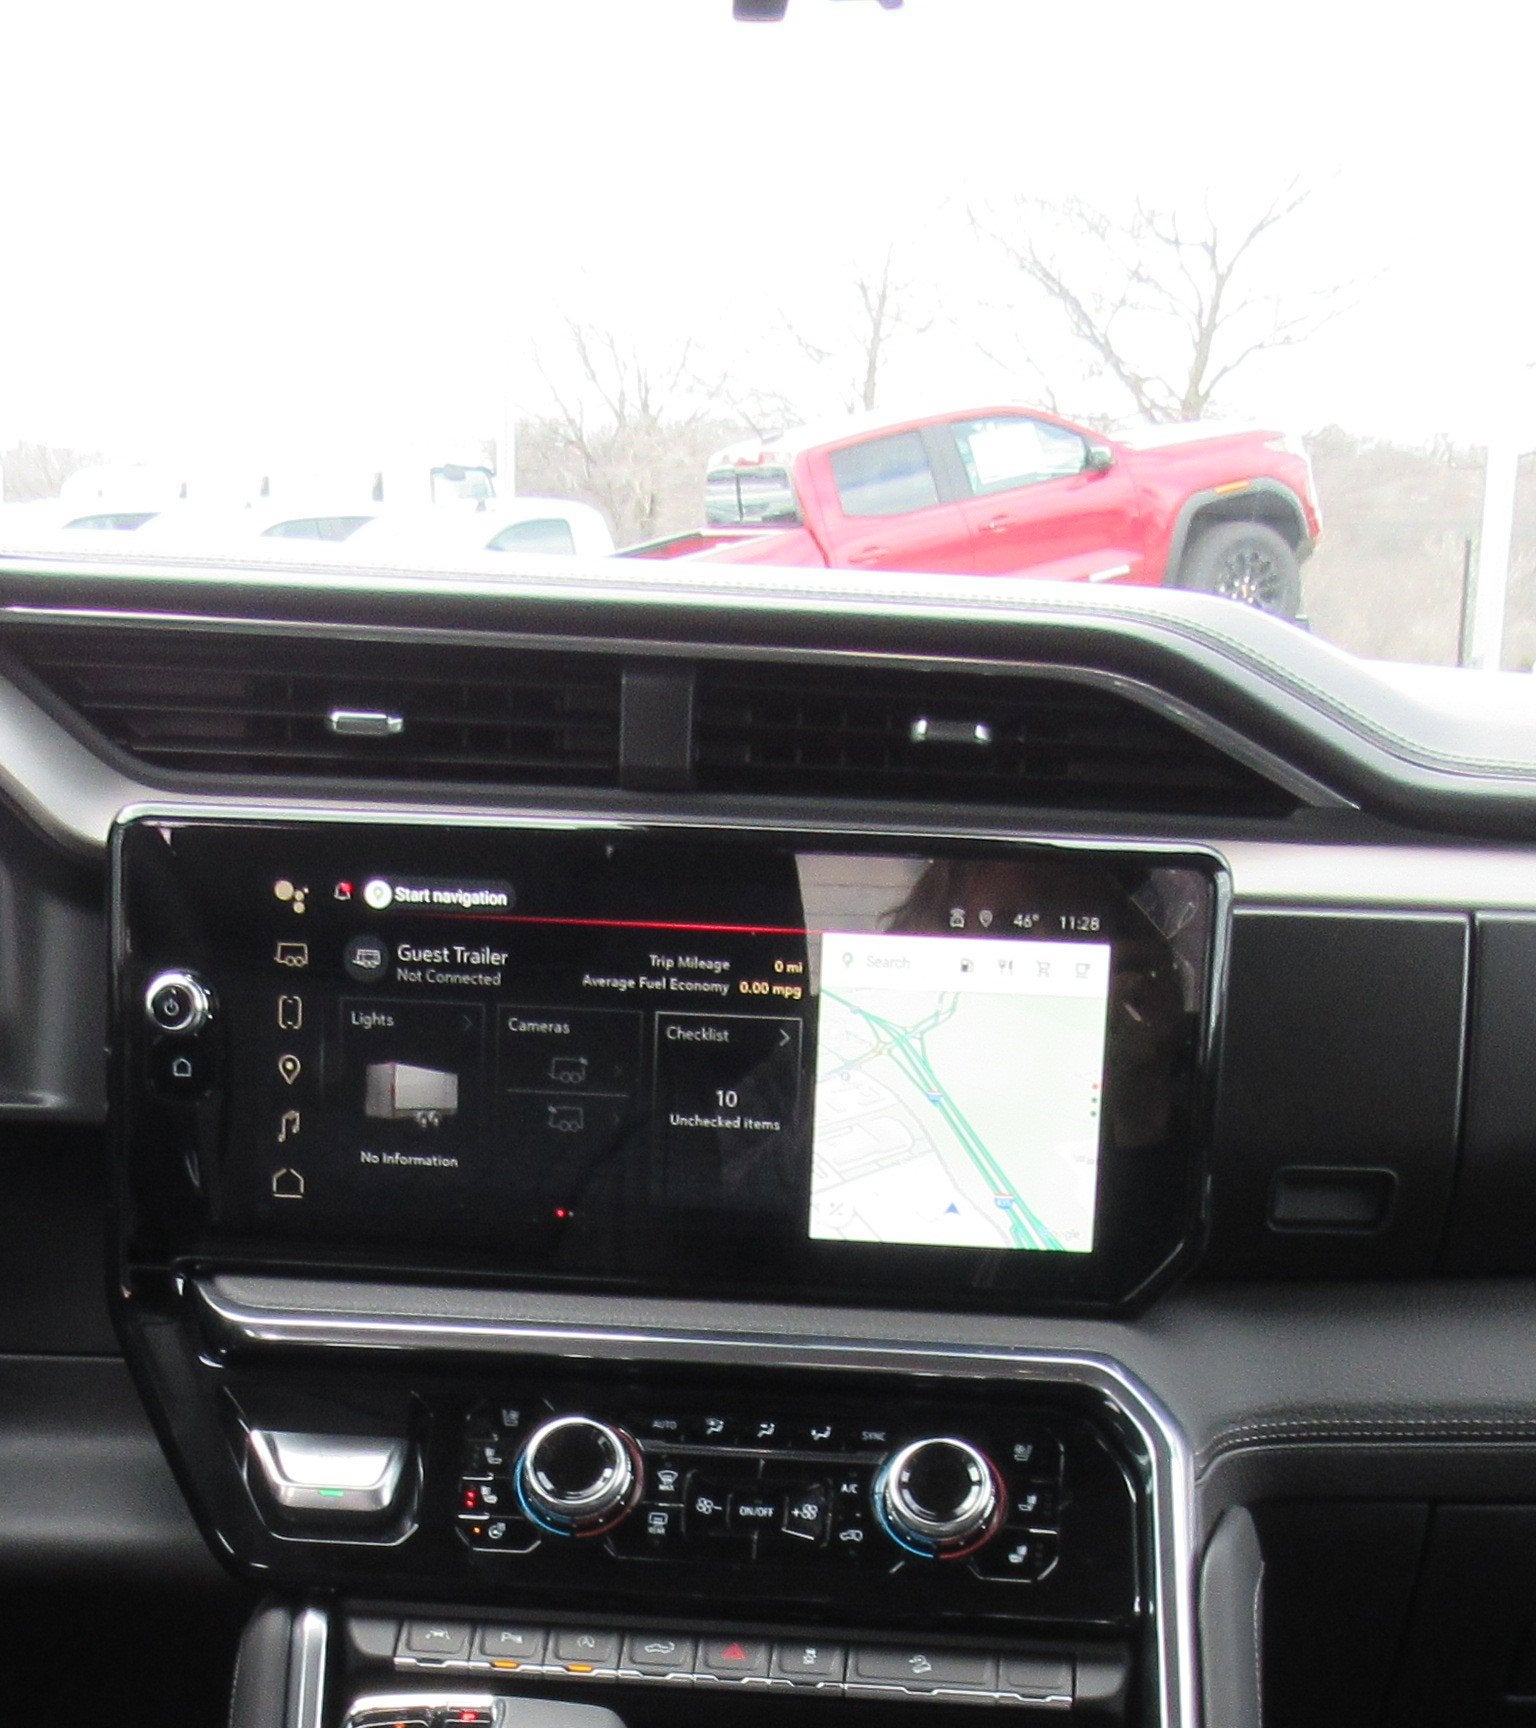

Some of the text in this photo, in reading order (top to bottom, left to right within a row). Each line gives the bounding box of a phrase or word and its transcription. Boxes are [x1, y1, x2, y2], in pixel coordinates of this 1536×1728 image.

[394, 886, 508, 908] Start navigation
[1059, 915, 1101, 932] 11:28
[397, 944, 509, 966] Guest Trailer
[649, 954, 803, 974] Trip Mileage 0 mi
[867, 955, 911, 970] Search
[396, 967, 501, 986] Not Connected
[581, 974, 802, 999] Average Fuel Economy 0.00 mpg
[351, 1010, 395, 1030] Lights
[508, 1017, 571, 1035] Cameras
[666, 1026, 730, 1043] Checklist
[716, 1090, 738, 1108] 10
[669, 1113, 781, 1131] Unchecked items
[360, 1151, 459, 1168] No Information
[840, 1482, 860, 1495] A/C
[739, 1506, 775, 1519] ON/OFF
